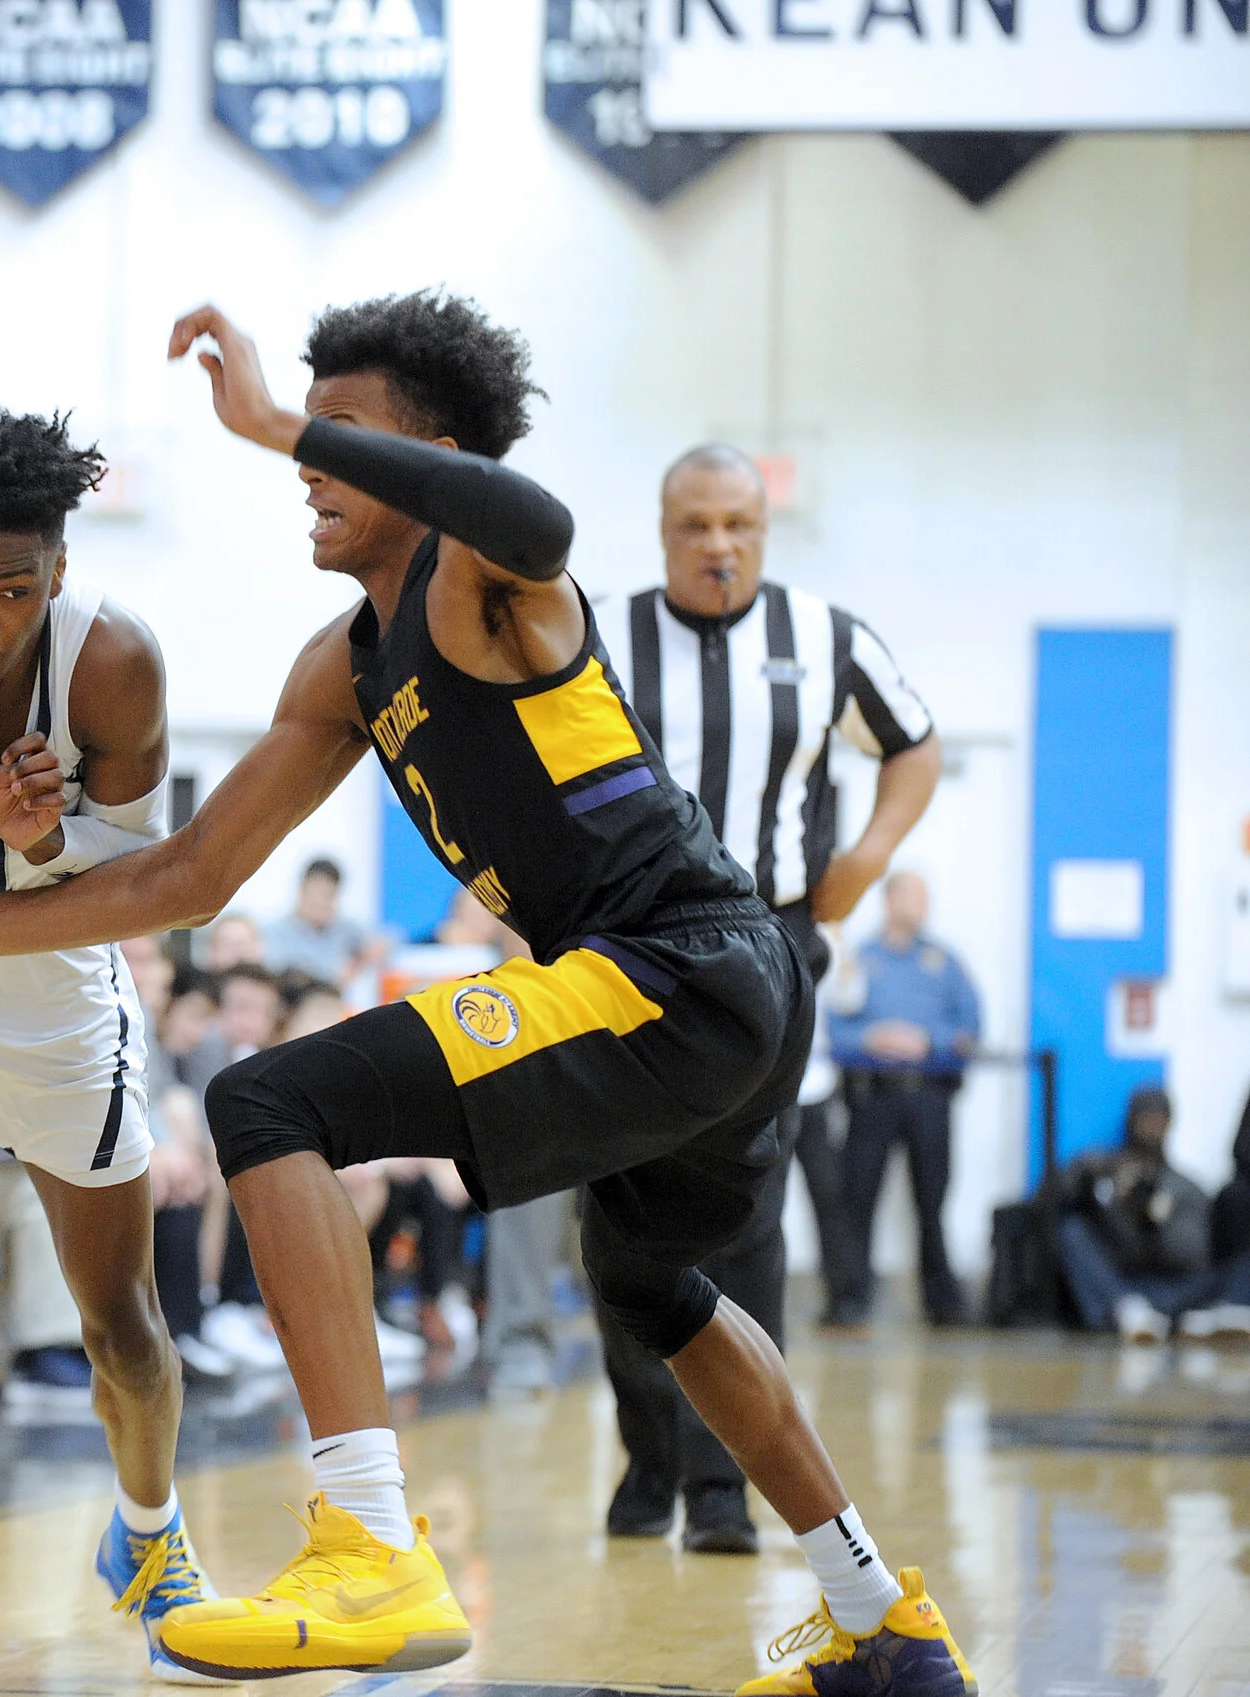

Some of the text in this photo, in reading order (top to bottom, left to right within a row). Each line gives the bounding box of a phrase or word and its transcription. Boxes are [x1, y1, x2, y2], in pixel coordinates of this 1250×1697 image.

[239, 0, 422, 41] NCAA
[253, 86, 411, 149] 2010
[405, 764, 465, 864] 2
